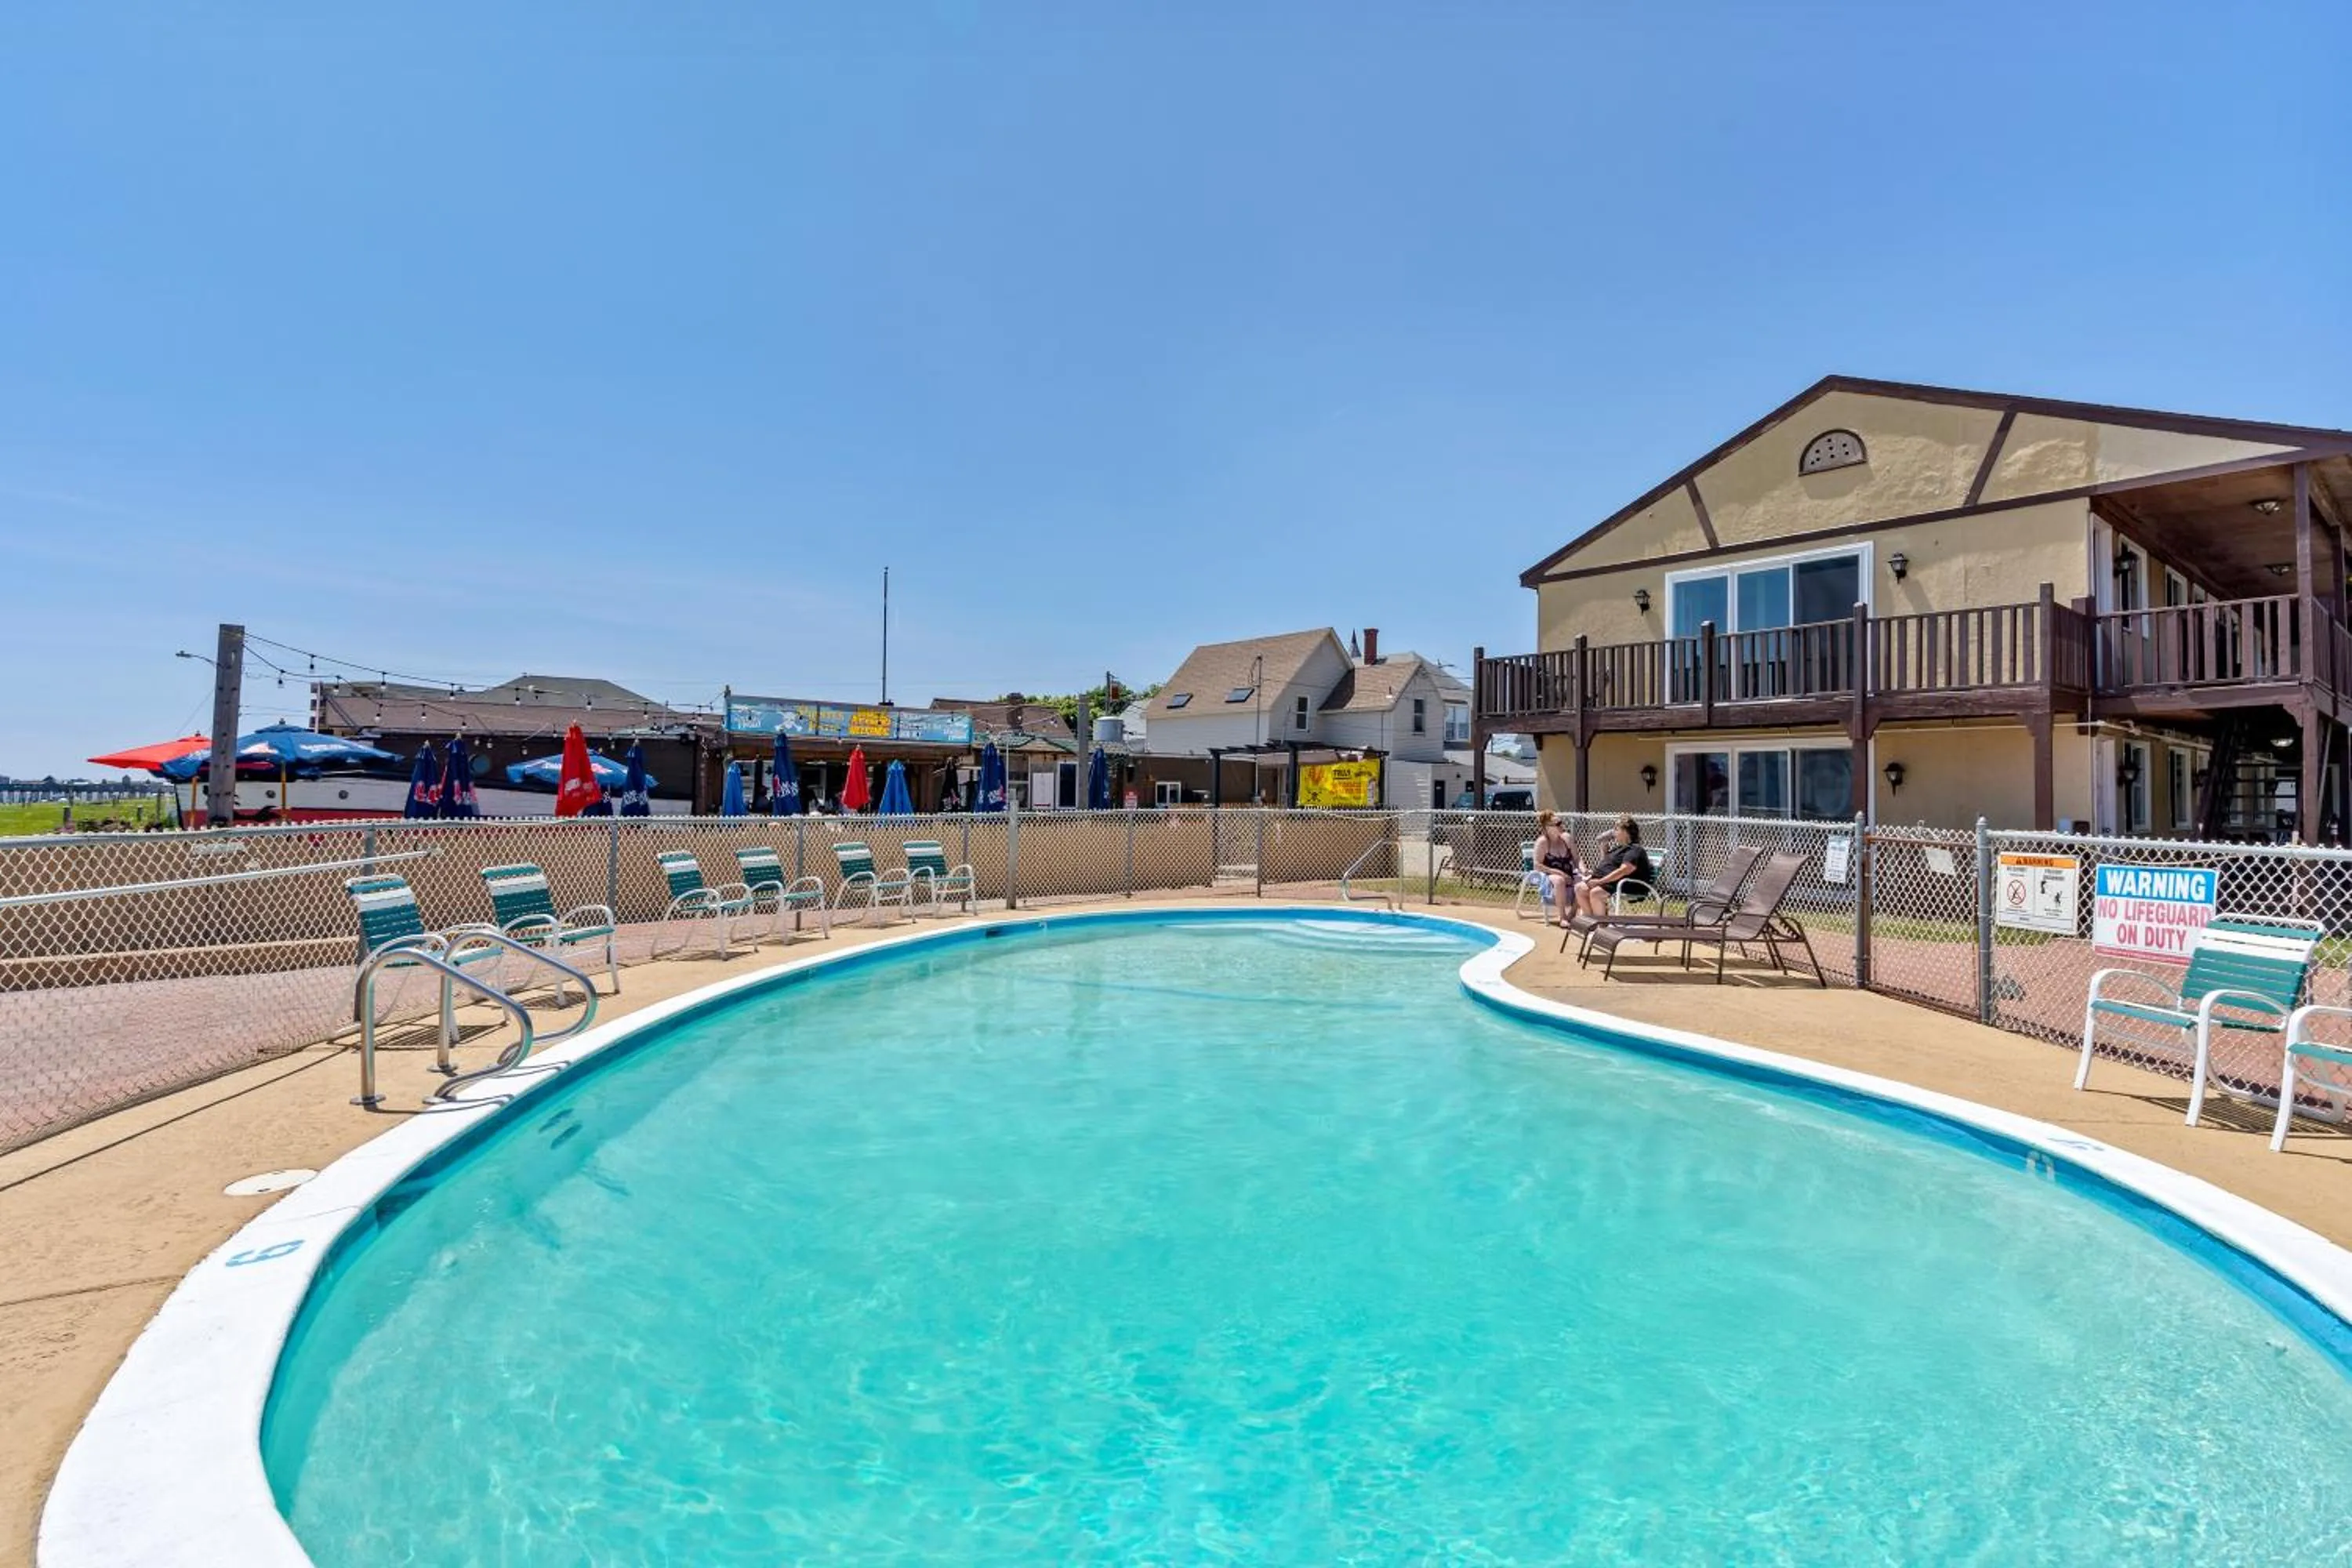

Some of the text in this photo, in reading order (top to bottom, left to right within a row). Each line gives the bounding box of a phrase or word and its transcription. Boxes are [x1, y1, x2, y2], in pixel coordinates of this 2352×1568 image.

[2106, 869, 2205, 901] WARNING
[2098, 898, 2212, 928] NO LIFEGUARD
[2118, 923, 2187, 951] ON DUTY
